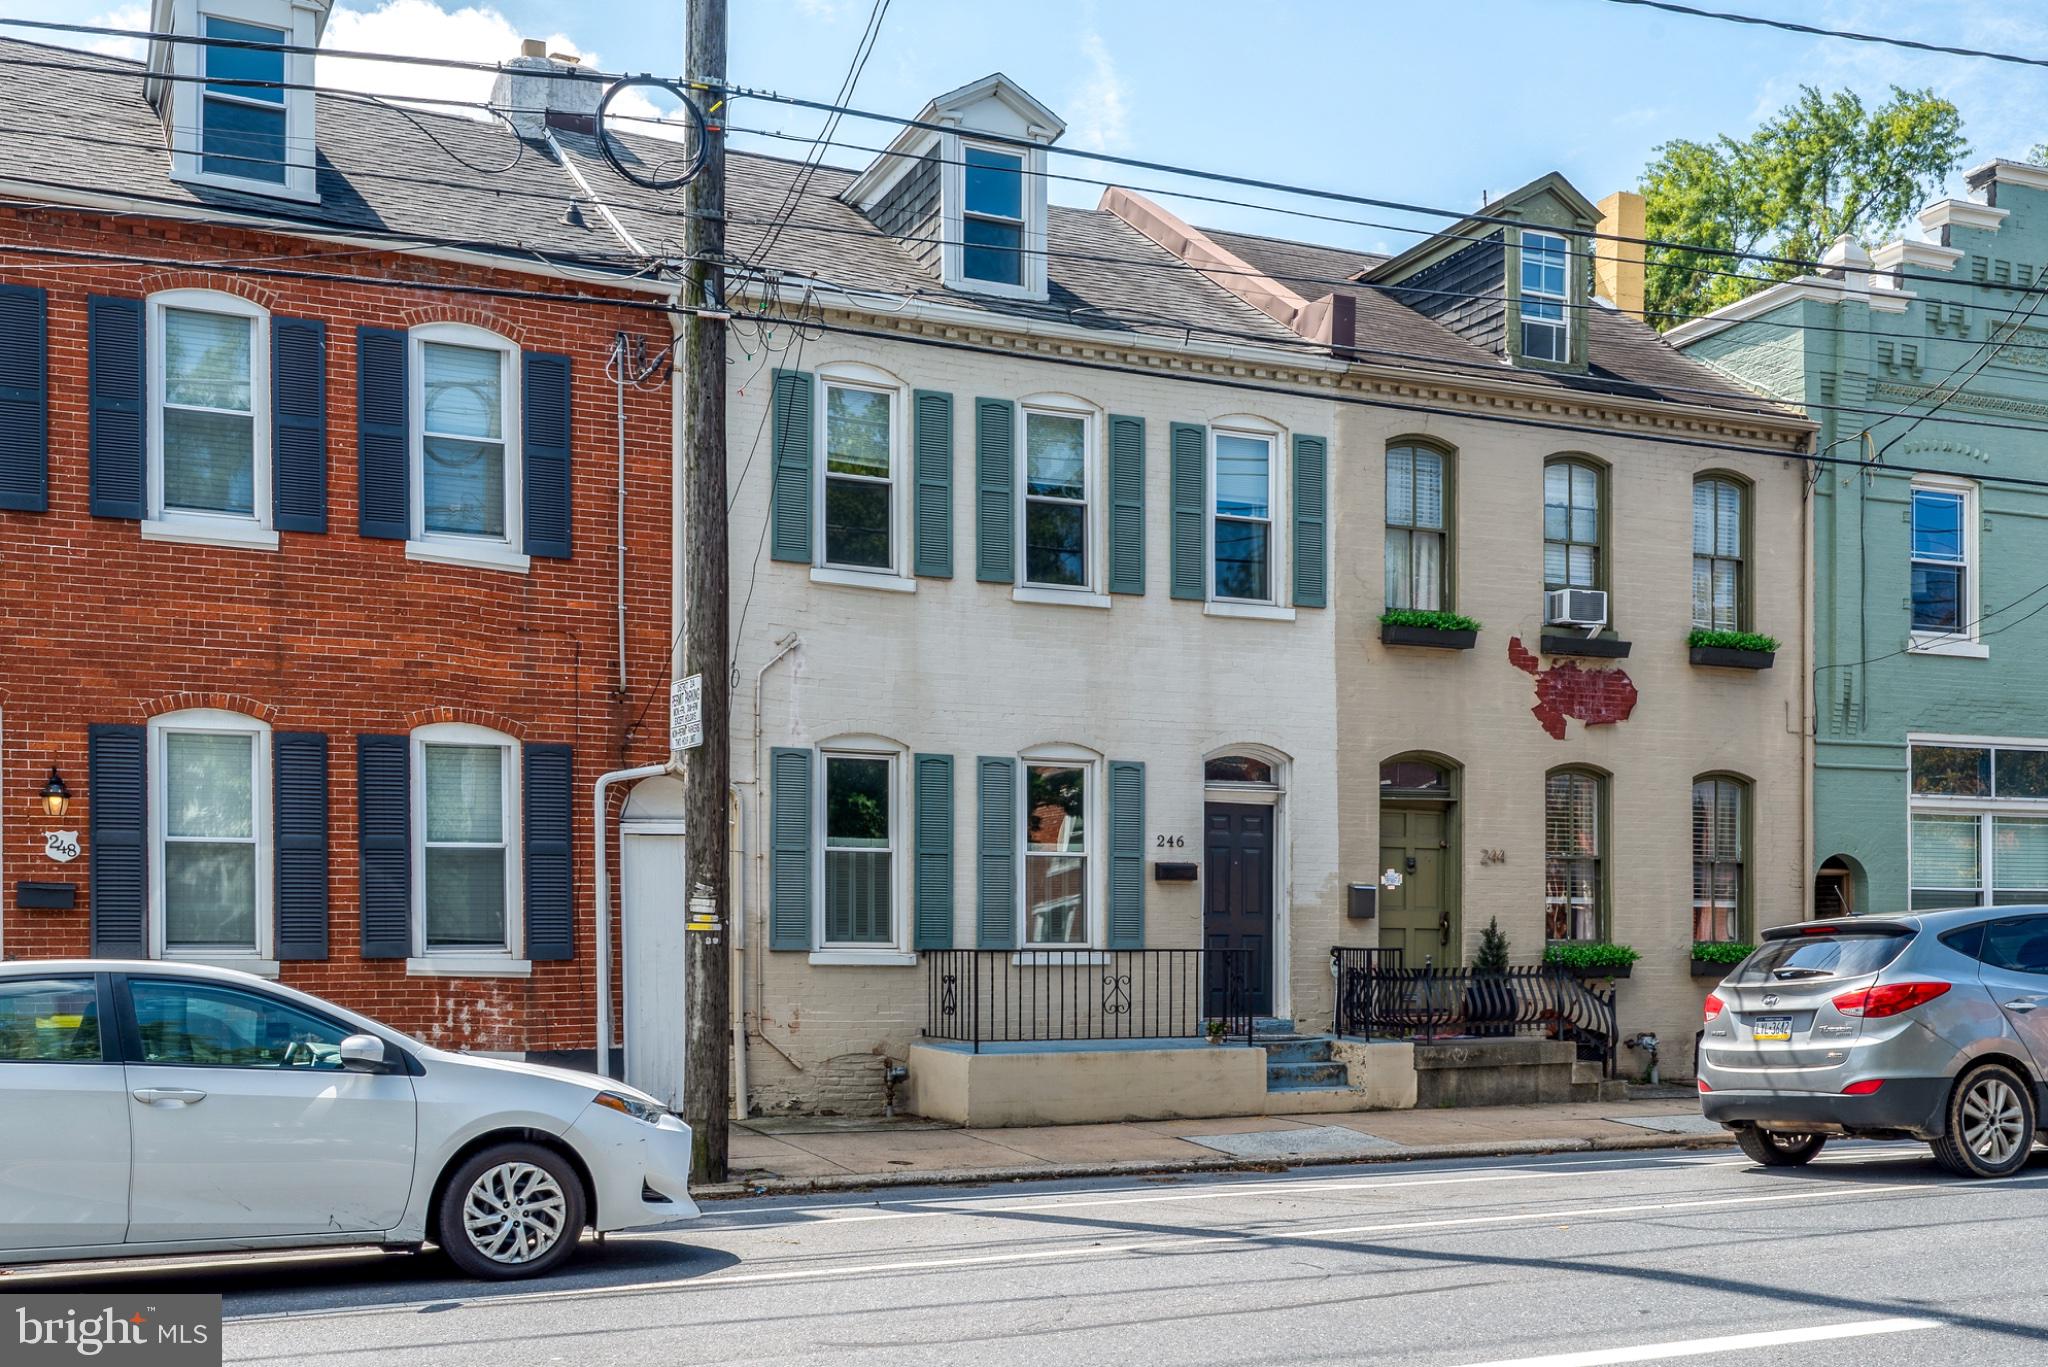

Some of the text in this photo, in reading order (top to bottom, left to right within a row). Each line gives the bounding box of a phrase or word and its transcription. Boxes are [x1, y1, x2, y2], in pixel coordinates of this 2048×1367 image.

[49, 834, 77, 857] 248
[1156, 834, 1185, 848] 246
[1480, 848, 1504, 865] 244
